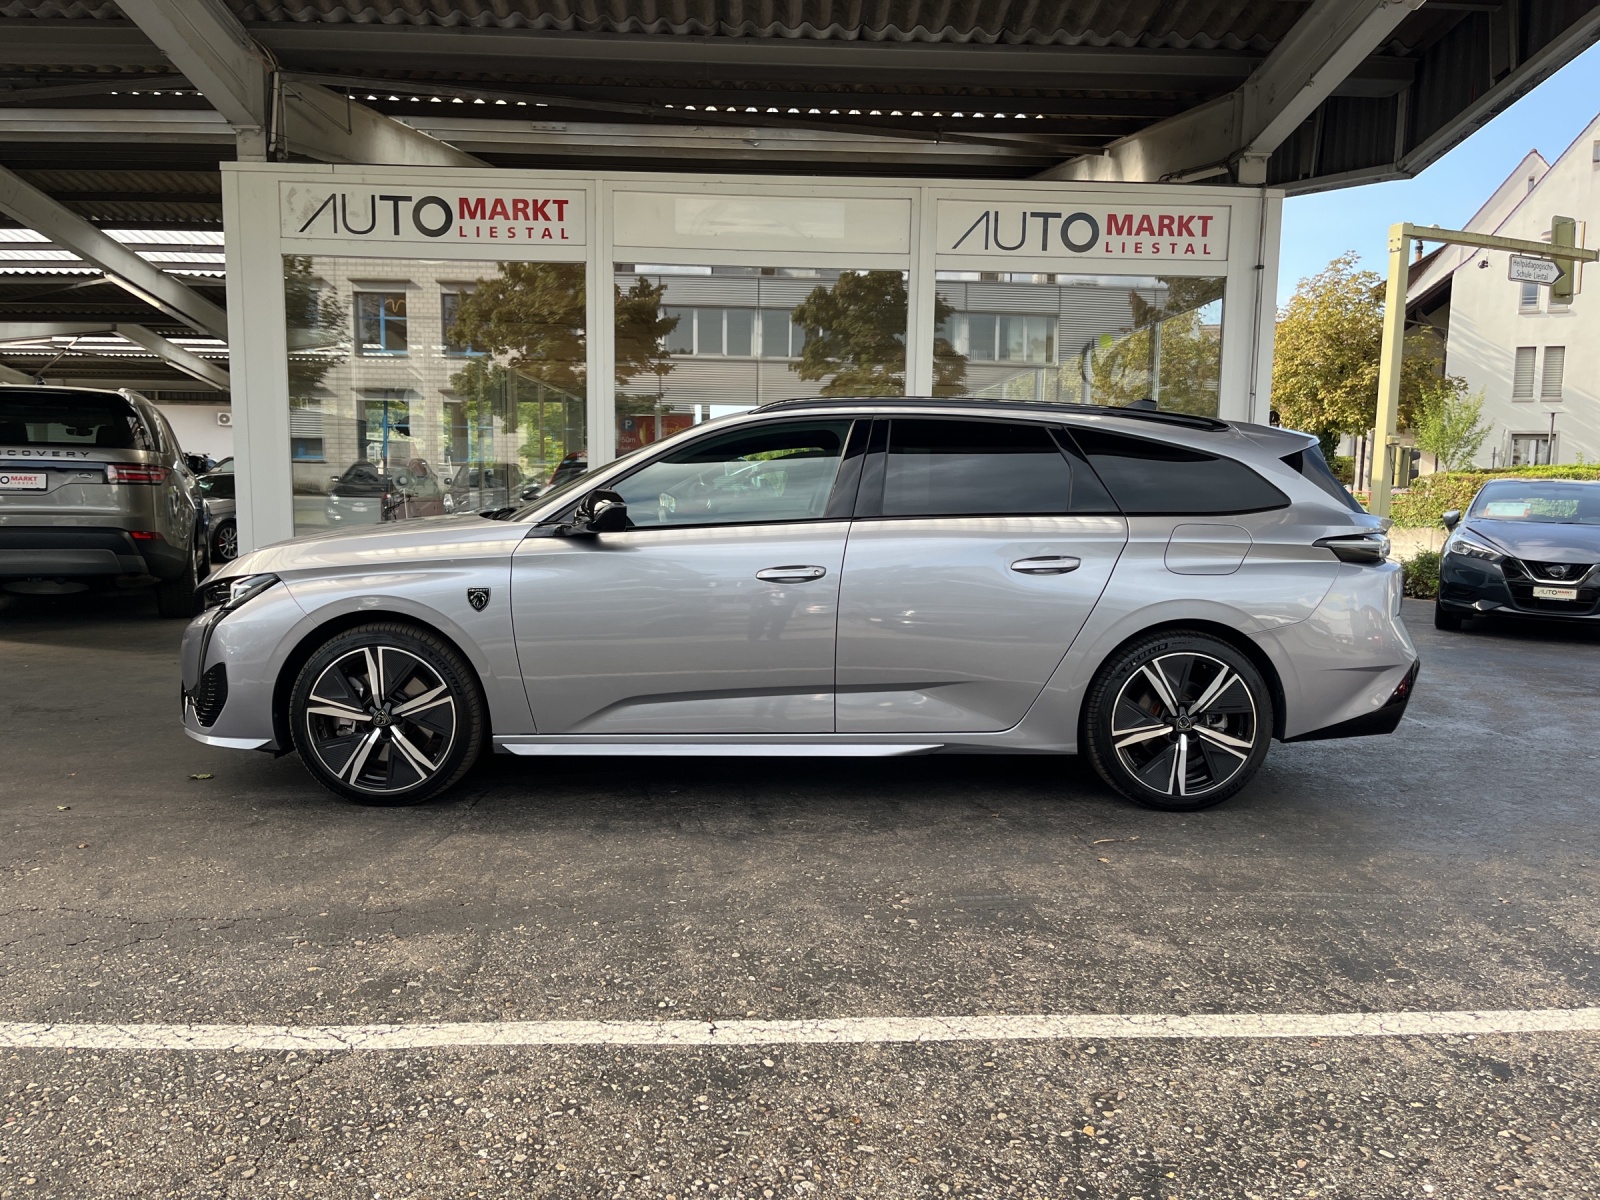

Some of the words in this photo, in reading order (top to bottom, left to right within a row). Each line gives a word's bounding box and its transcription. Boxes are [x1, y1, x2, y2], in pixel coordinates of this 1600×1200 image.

[299, 193, 454, 238] AUTO
[458, 197, 569, 222] MARKT
[459, 225, 569, 240] LIESTAL
[951, 210, 1100, 253] AUTO
[1105, 213, 1214, 238] MARKT
[1105, 241, 1211, 255] LIESTAL
[1512, 259, 1554, 272] Heilpädagogische
[1516, 269, 1532, 279] Schule
[1533, 270, 1549, 281] Liestal
[0, 449, 90, 458] COVERY
[1537, 588, 1558, 596] AUTO
[1124, 642, 1168, 672] MICHELIN
